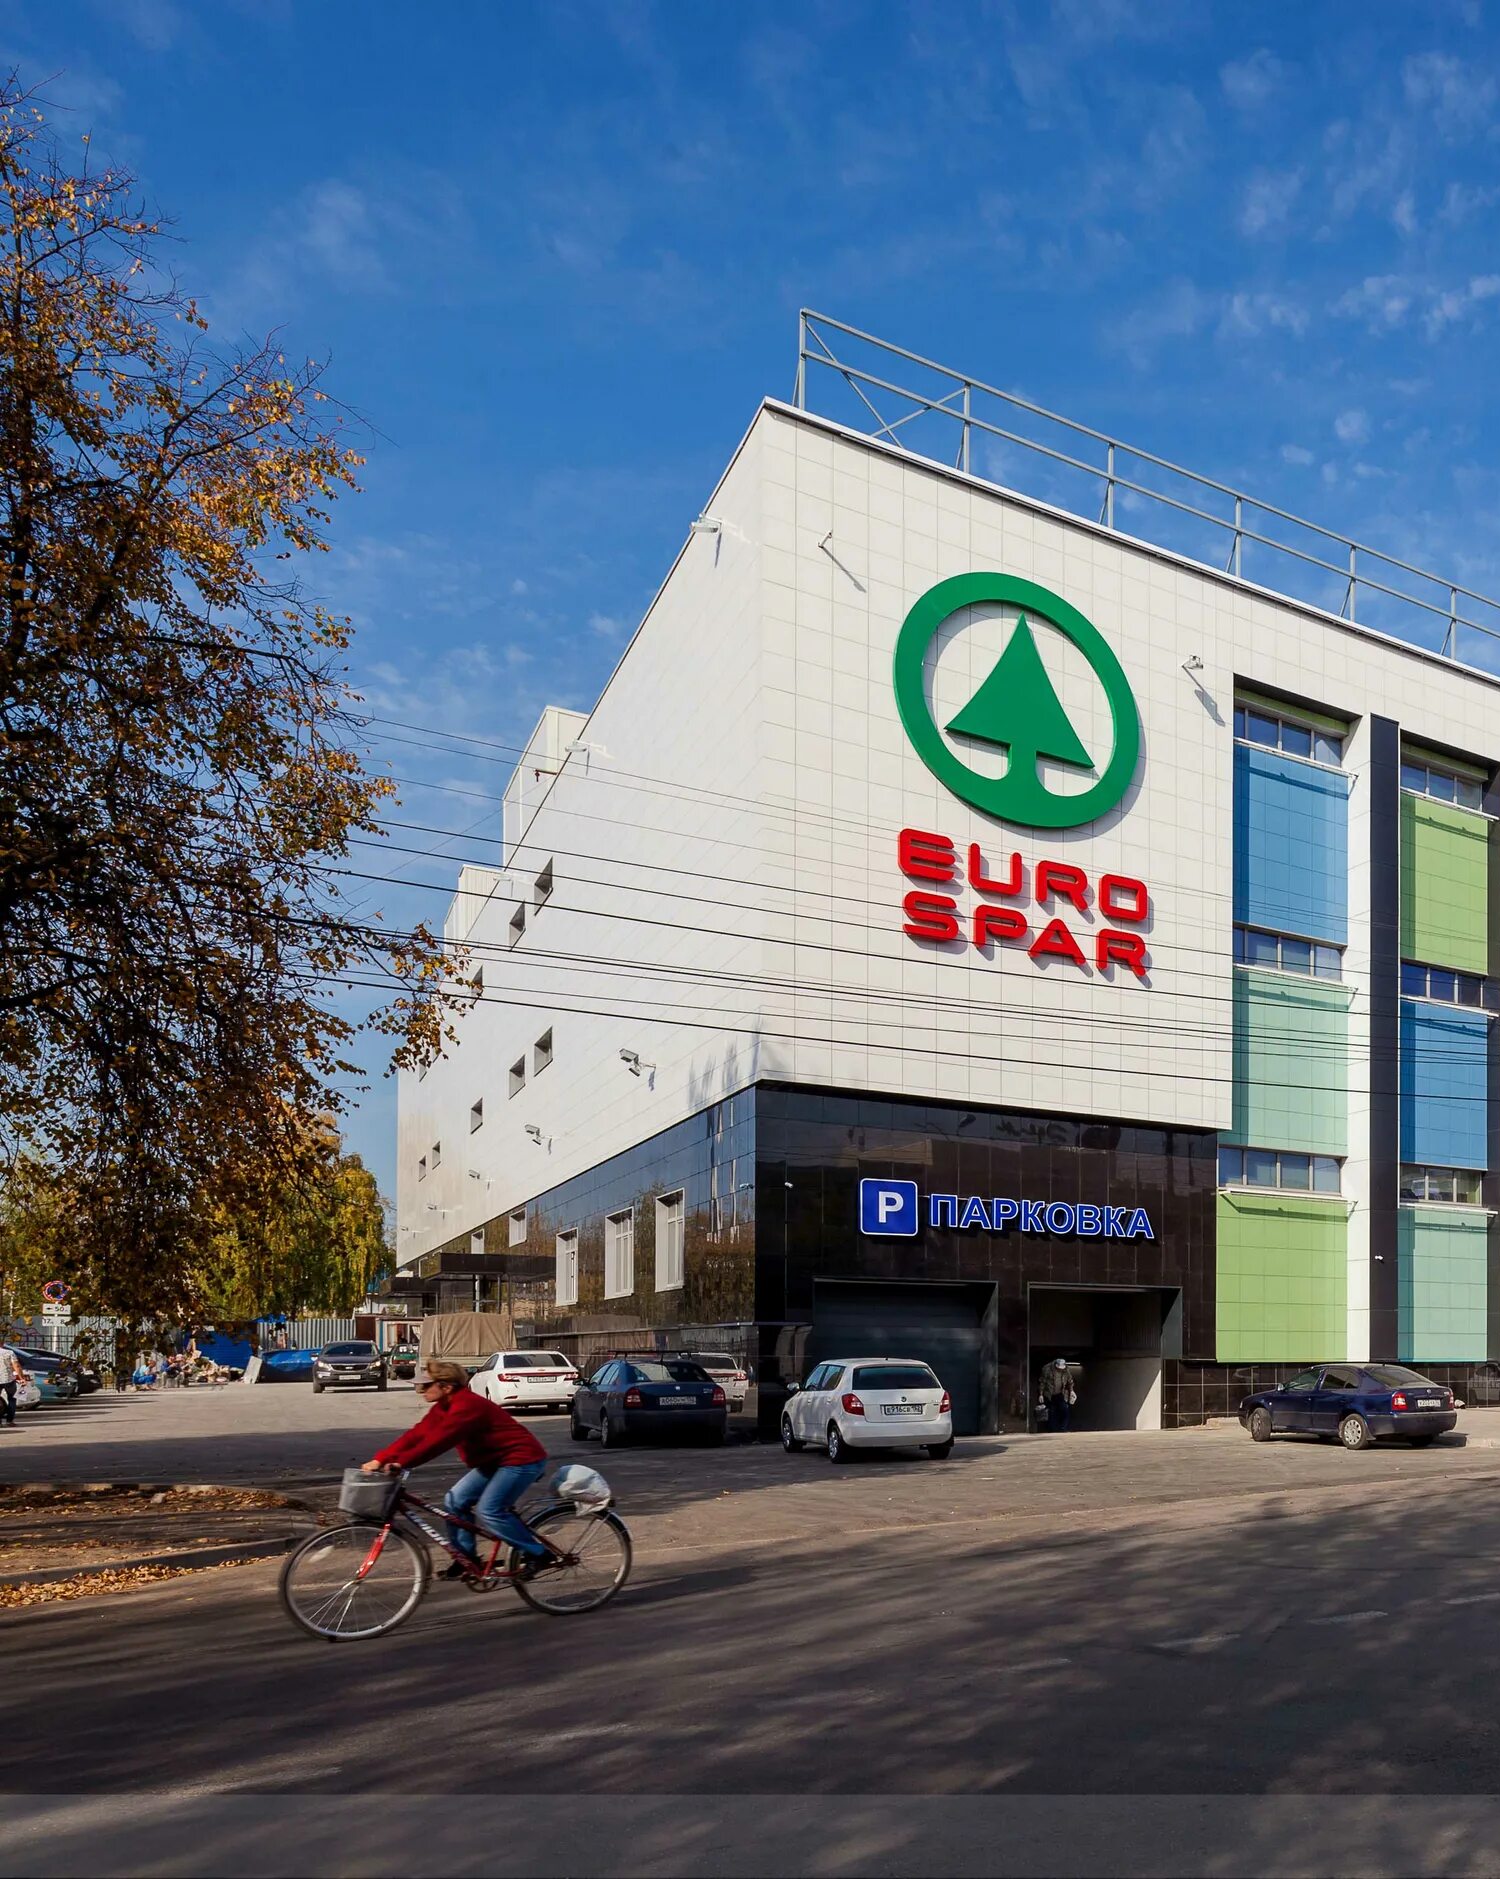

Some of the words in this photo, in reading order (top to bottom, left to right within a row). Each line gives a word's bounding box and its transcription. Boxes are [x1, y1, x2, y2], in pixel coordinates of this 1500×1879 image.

[898, 828, 1148, 922] EURO
[902, 891, 1147, 978] SPAR
[928, 1193, 1156, 1241] ПАРКОВКА
